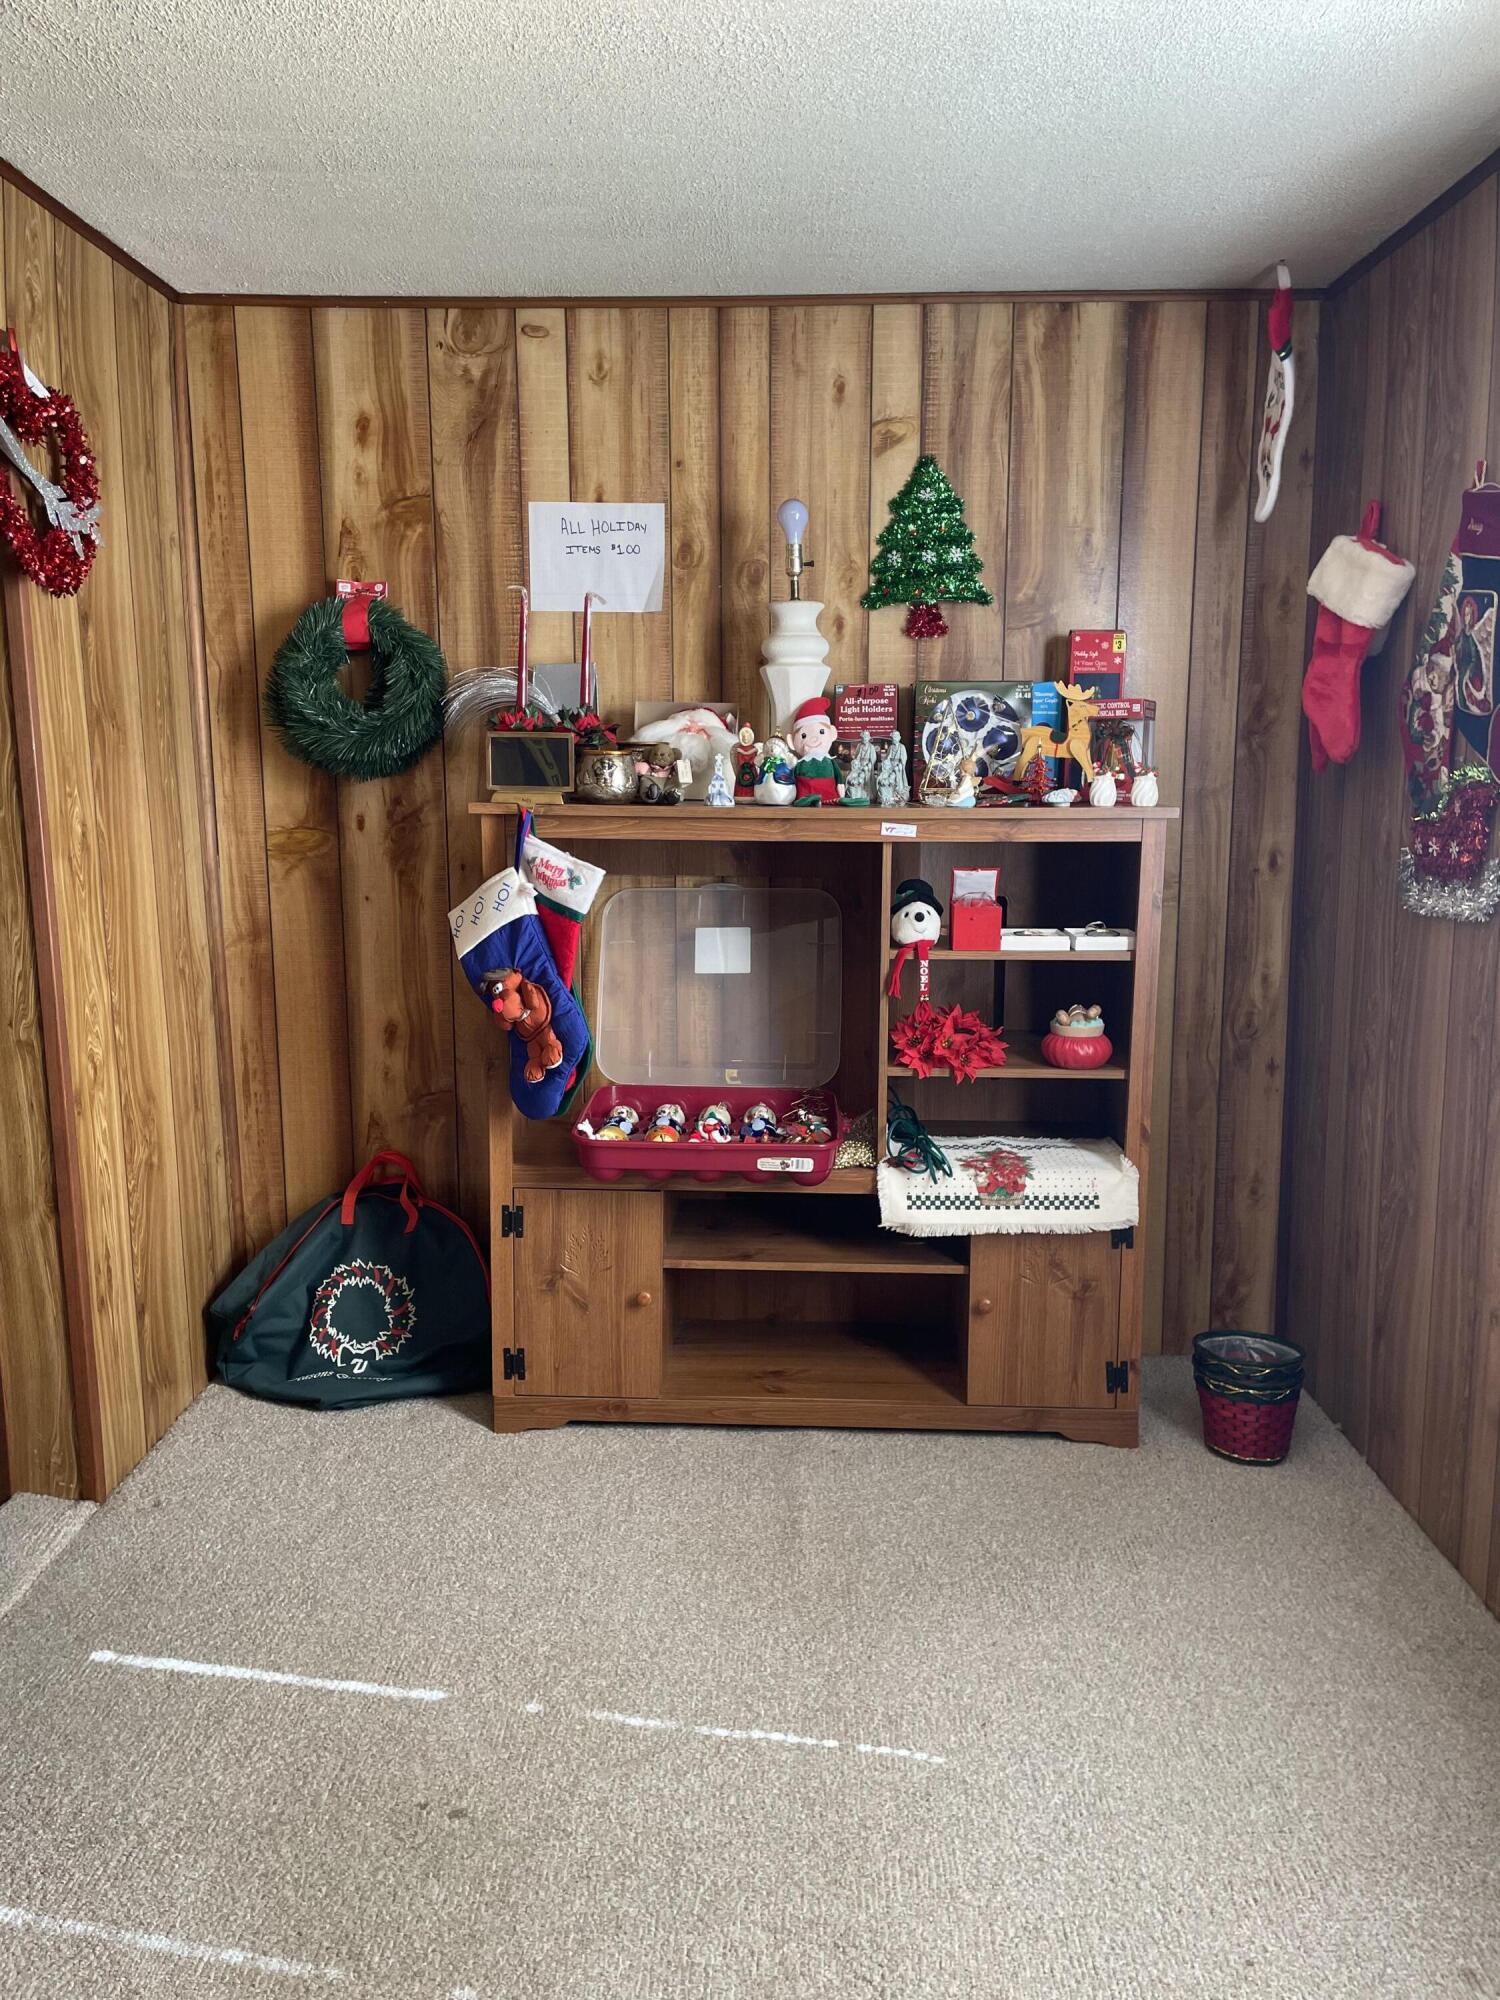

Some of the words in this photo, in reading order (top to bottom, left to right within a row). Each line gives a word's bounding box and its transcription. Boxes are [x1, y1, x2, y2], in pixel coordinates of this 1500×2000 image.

[561, 517, 586, 535] ALL
[591, 519, 647, 536] HOLIDAY
[565, 545, 601, 555] ITEMS
[840, 705, 860, 714] Light
[861, 705, 893, 713] Holders
[843, 697, 889, 706] All-Purpose
[539, 857, 565, 878] Merry
[454, 909, 466, 939] HO!
[470, 896, 487, 926] HO!
[493, 882, 514, 912] HO!
[920, 960, 929, 992] NOEL
